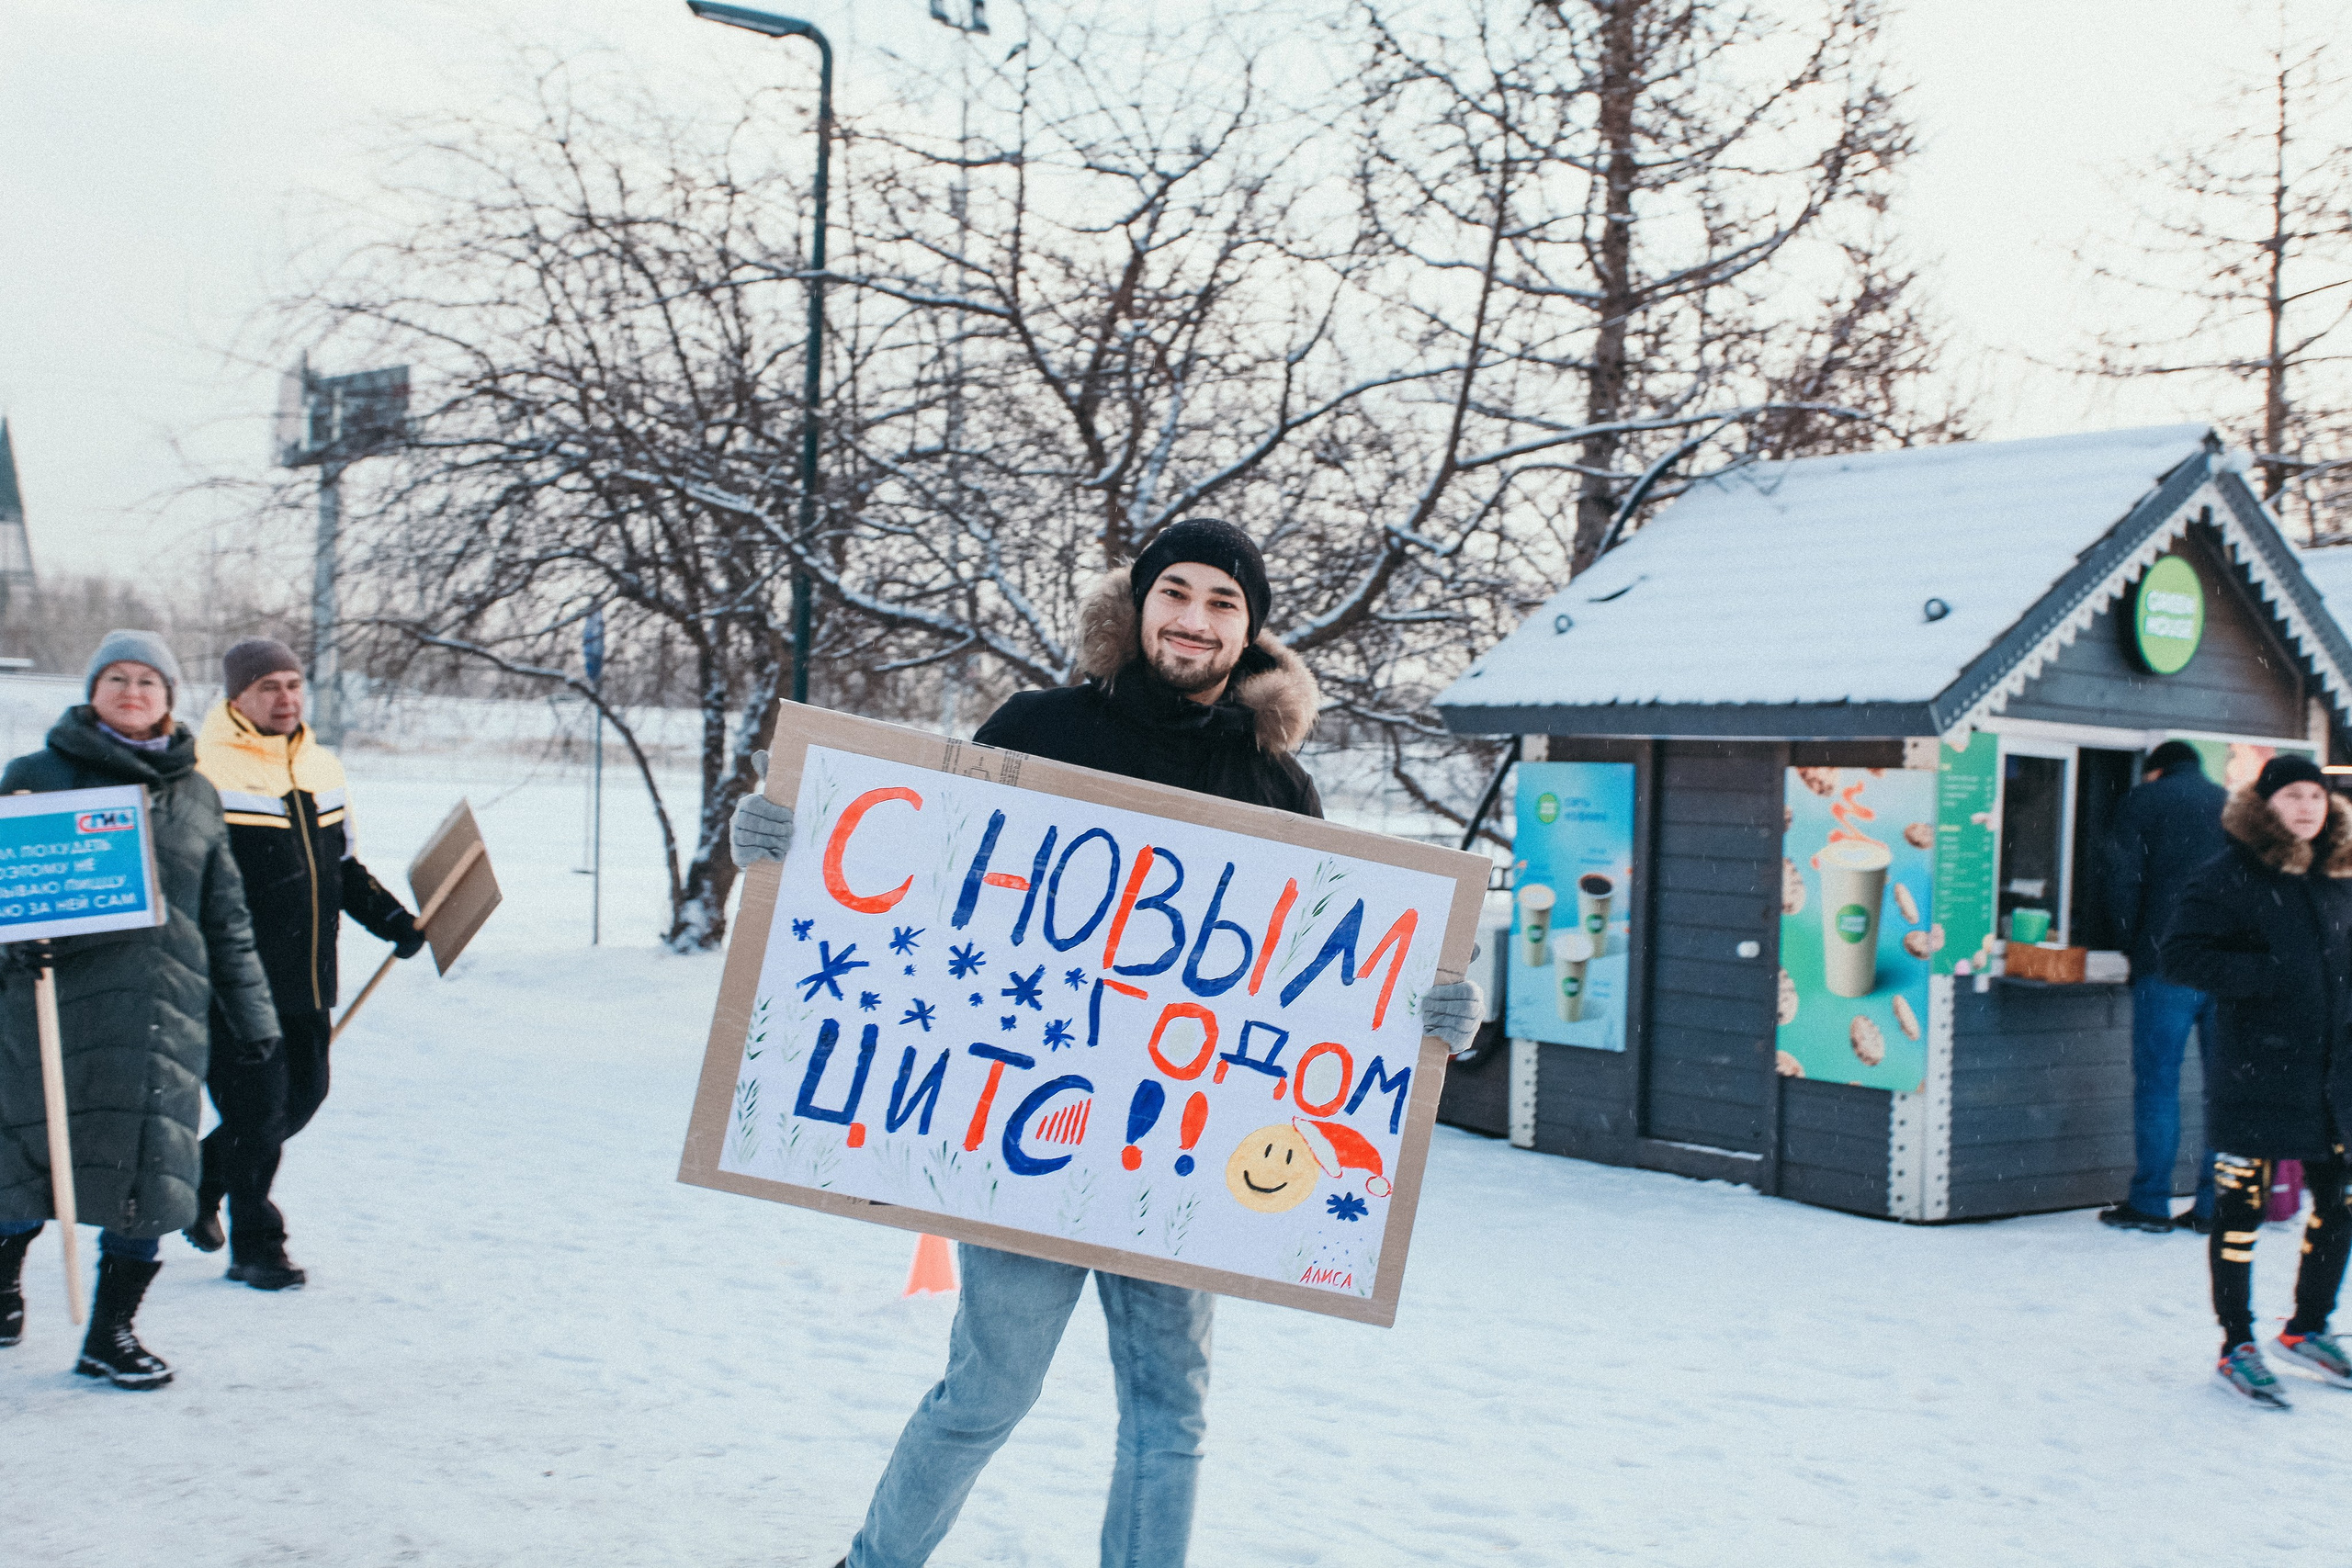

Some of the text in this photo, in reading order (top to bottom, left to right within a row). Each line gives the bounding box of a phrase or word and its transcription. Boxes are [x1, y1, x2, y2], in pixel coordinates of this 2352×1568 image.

[28, 901, 51, 917] ЗА
[56, 894, 90, 912] НЕЙ
[93, 892, 137, 909] САМ
[821, 786, 1419, 1032] С НОВЫМ
[1088, 977, 1412, 1135] ГОДОМ
[1299, 1265, 1352, 1290] АЛИСА
